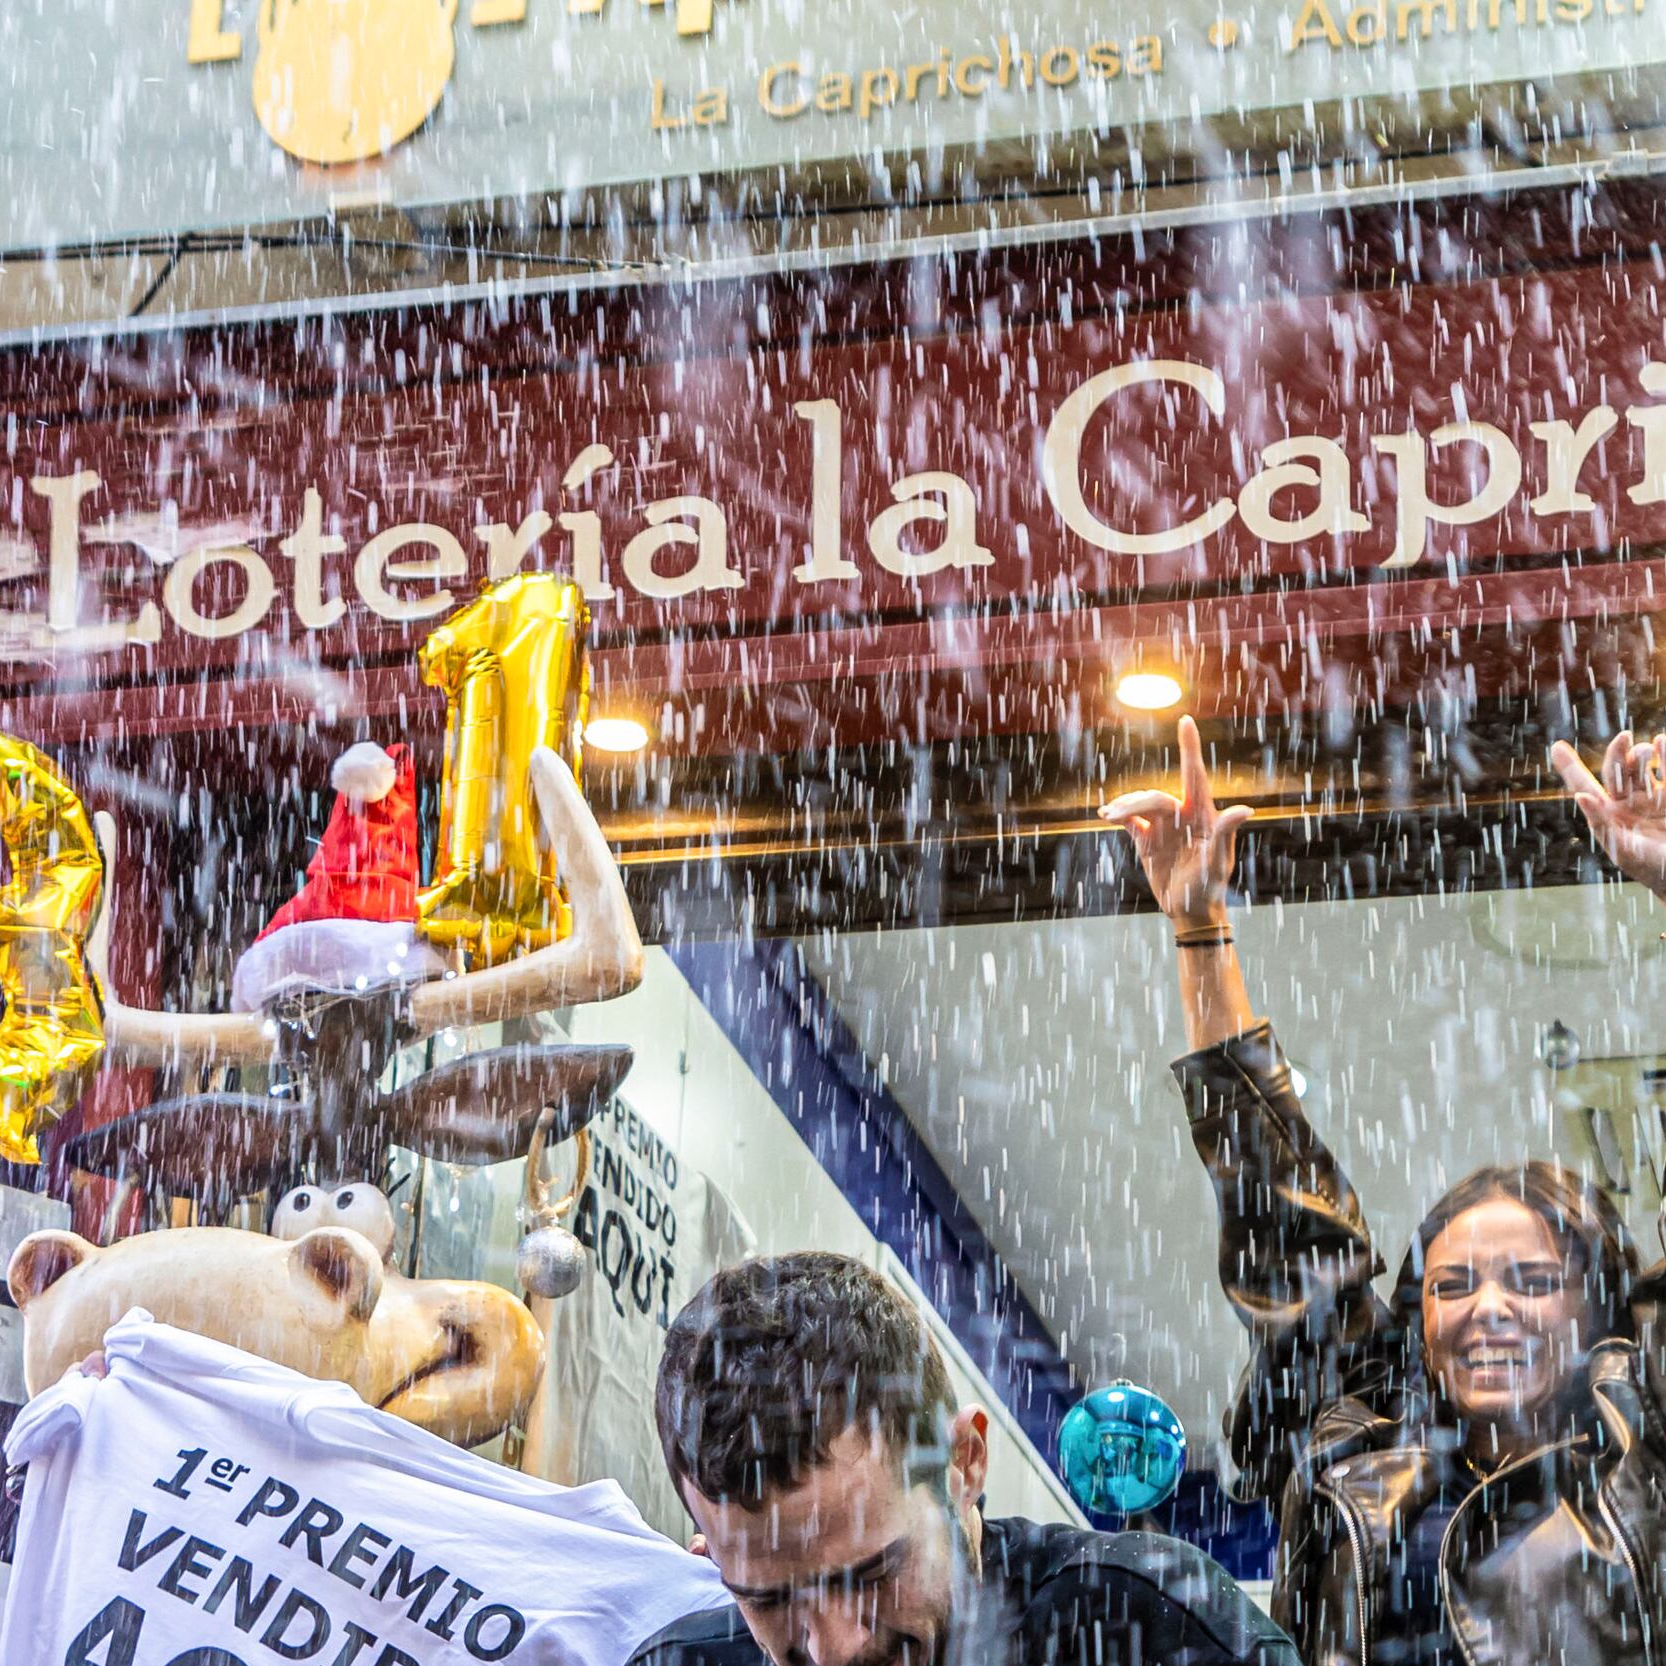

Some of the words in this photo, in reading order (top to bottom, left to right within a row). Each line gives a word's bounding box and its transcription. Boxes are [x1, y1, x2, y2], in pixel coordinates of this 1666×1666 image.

[649, 78, 731, 130] La
[757, 34, 1165, 120] Caprichosa
[28, 440, 745, 645] Lotería
[793, 398, 998, 585] la
[152, 1447, 250, 1500] 1er
[235, 1477, 526, 1662] PREMIO
